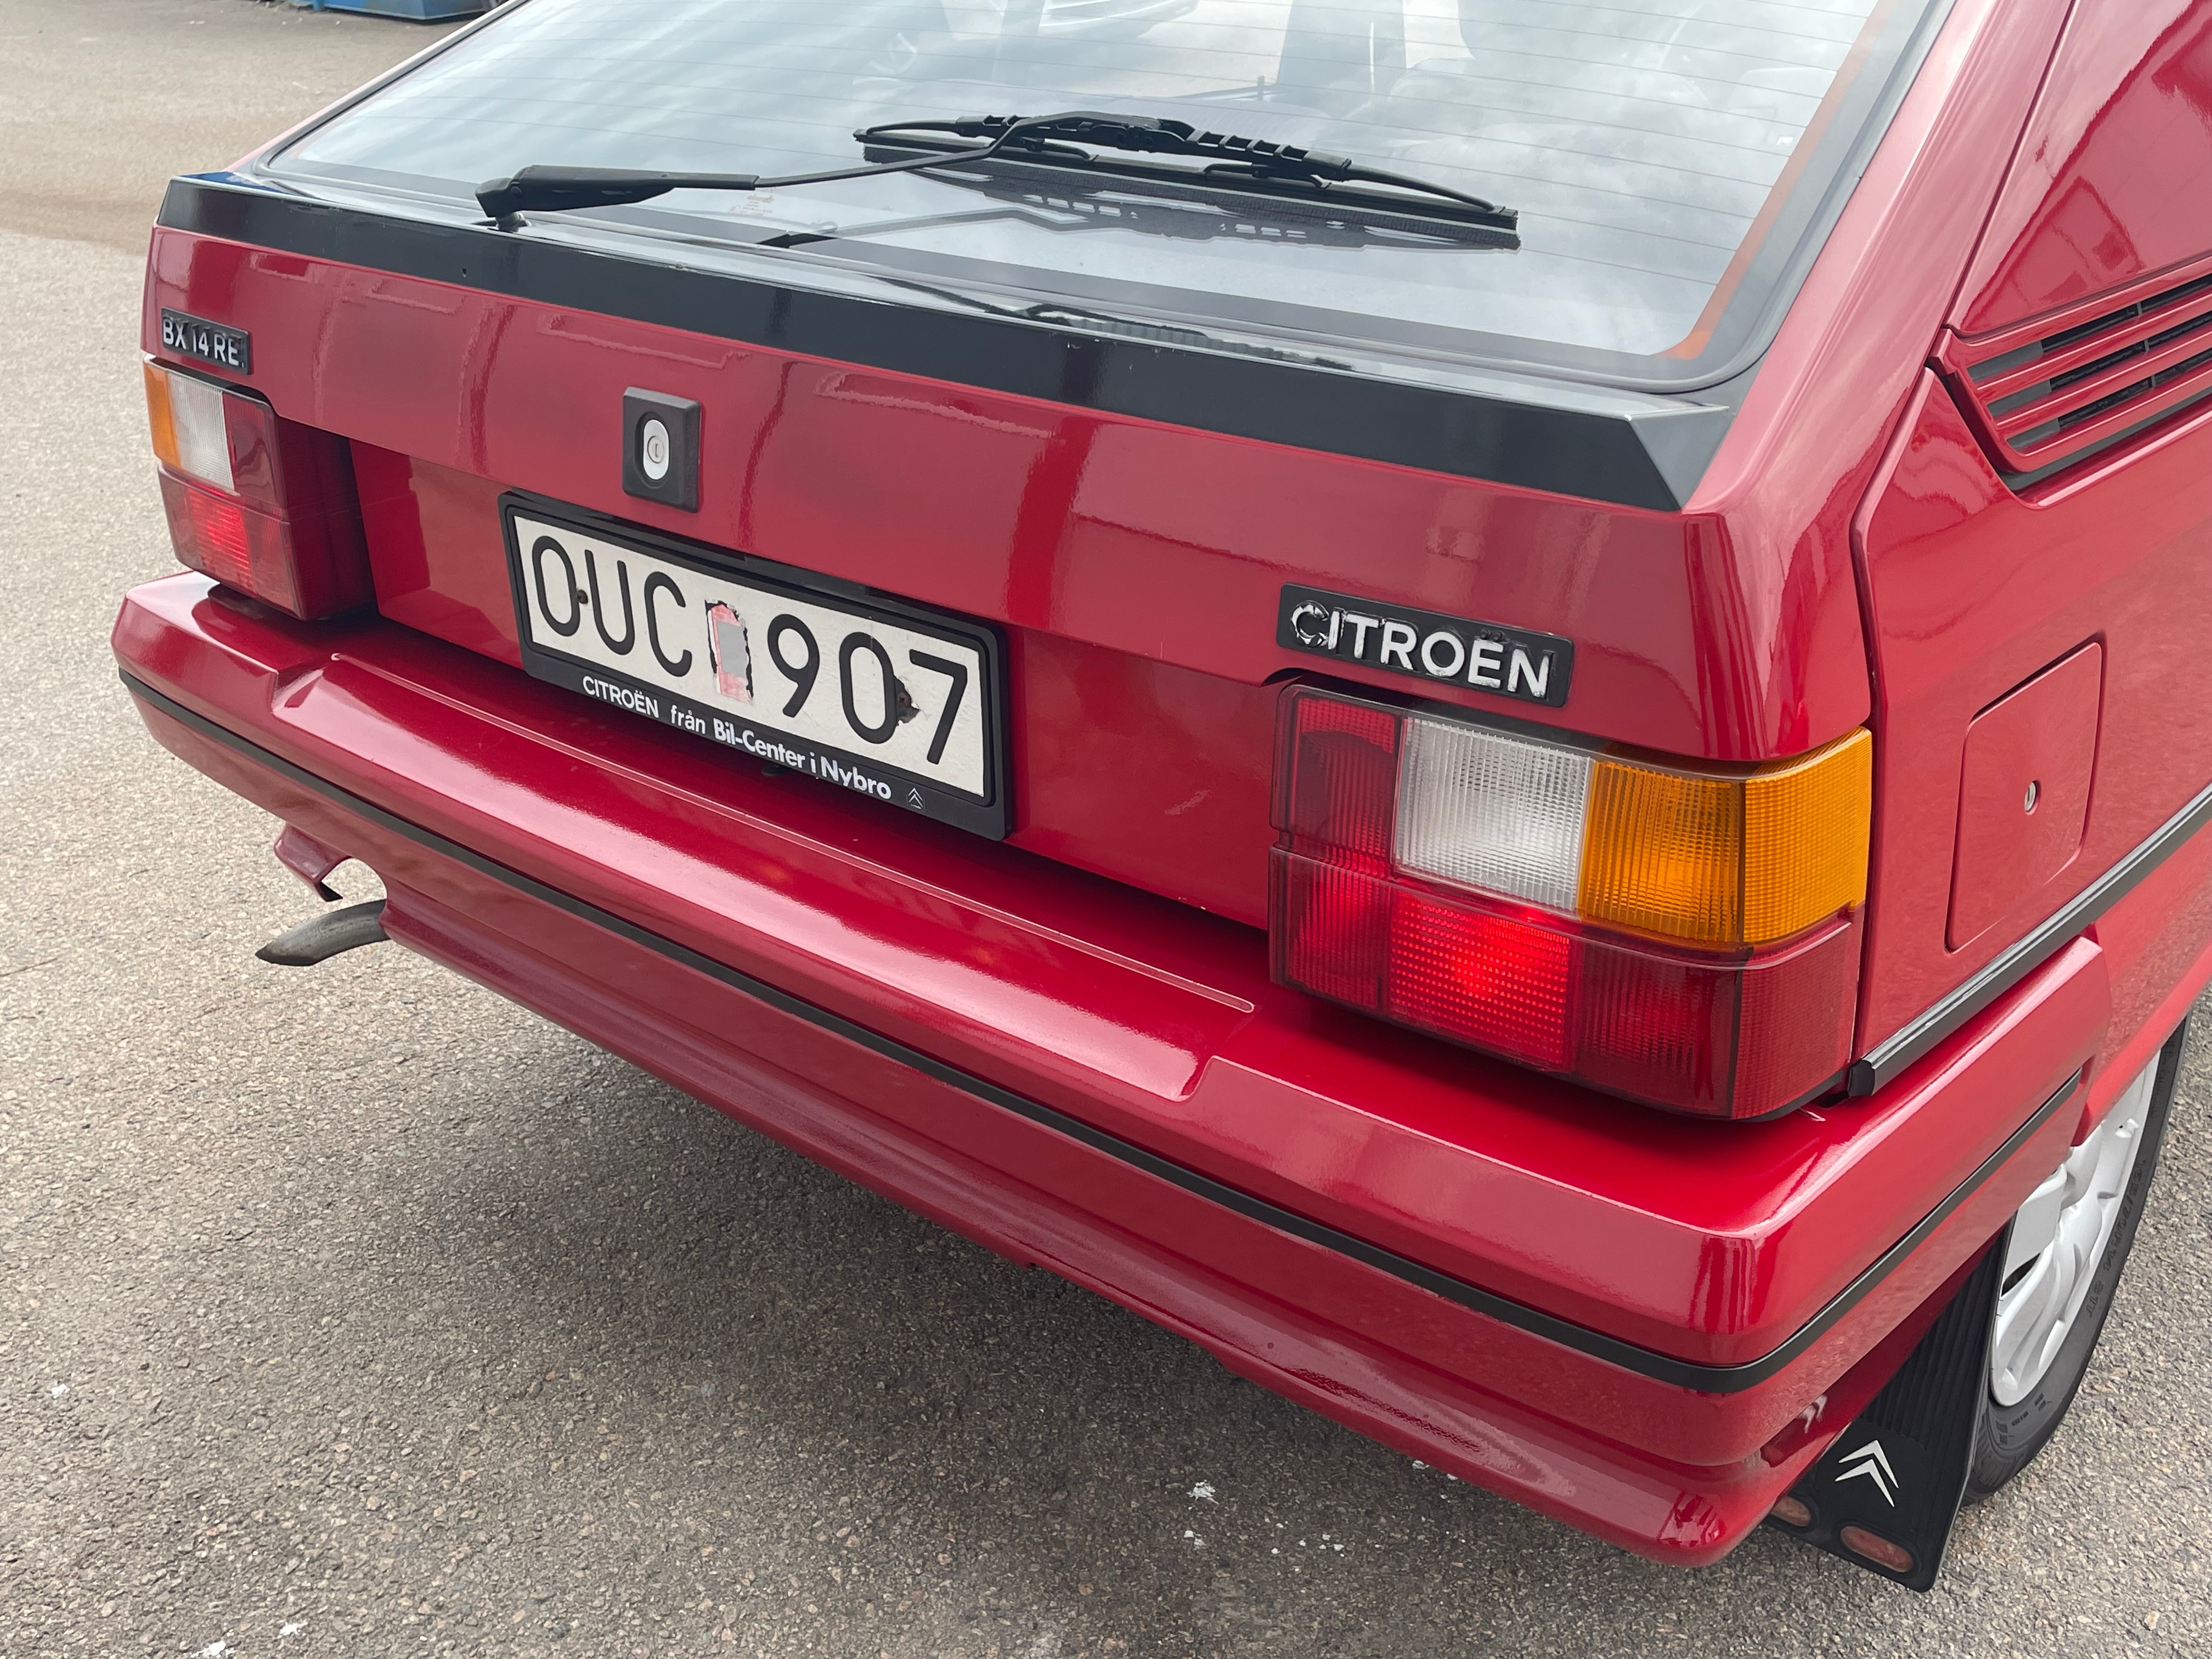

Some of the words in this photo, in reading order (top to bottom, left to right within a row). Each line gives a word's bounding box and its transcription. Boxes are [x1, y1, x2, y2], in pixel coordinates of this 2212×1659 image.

[162, 317, 188, 350] BX
[192, 325, 209, 356] 14
[213, 333, 239, 366] RE
[532, 535, 692, 678] OUC
[767, 613, 968, 765] 907
[583, 675, 659, 719] CITROËN
[670, 704, 706, 735] från
[713, 718, 806, 769] Bil-Center
[809, 751, 817, 774] i
[820, 755, 892, 800] Nybro
